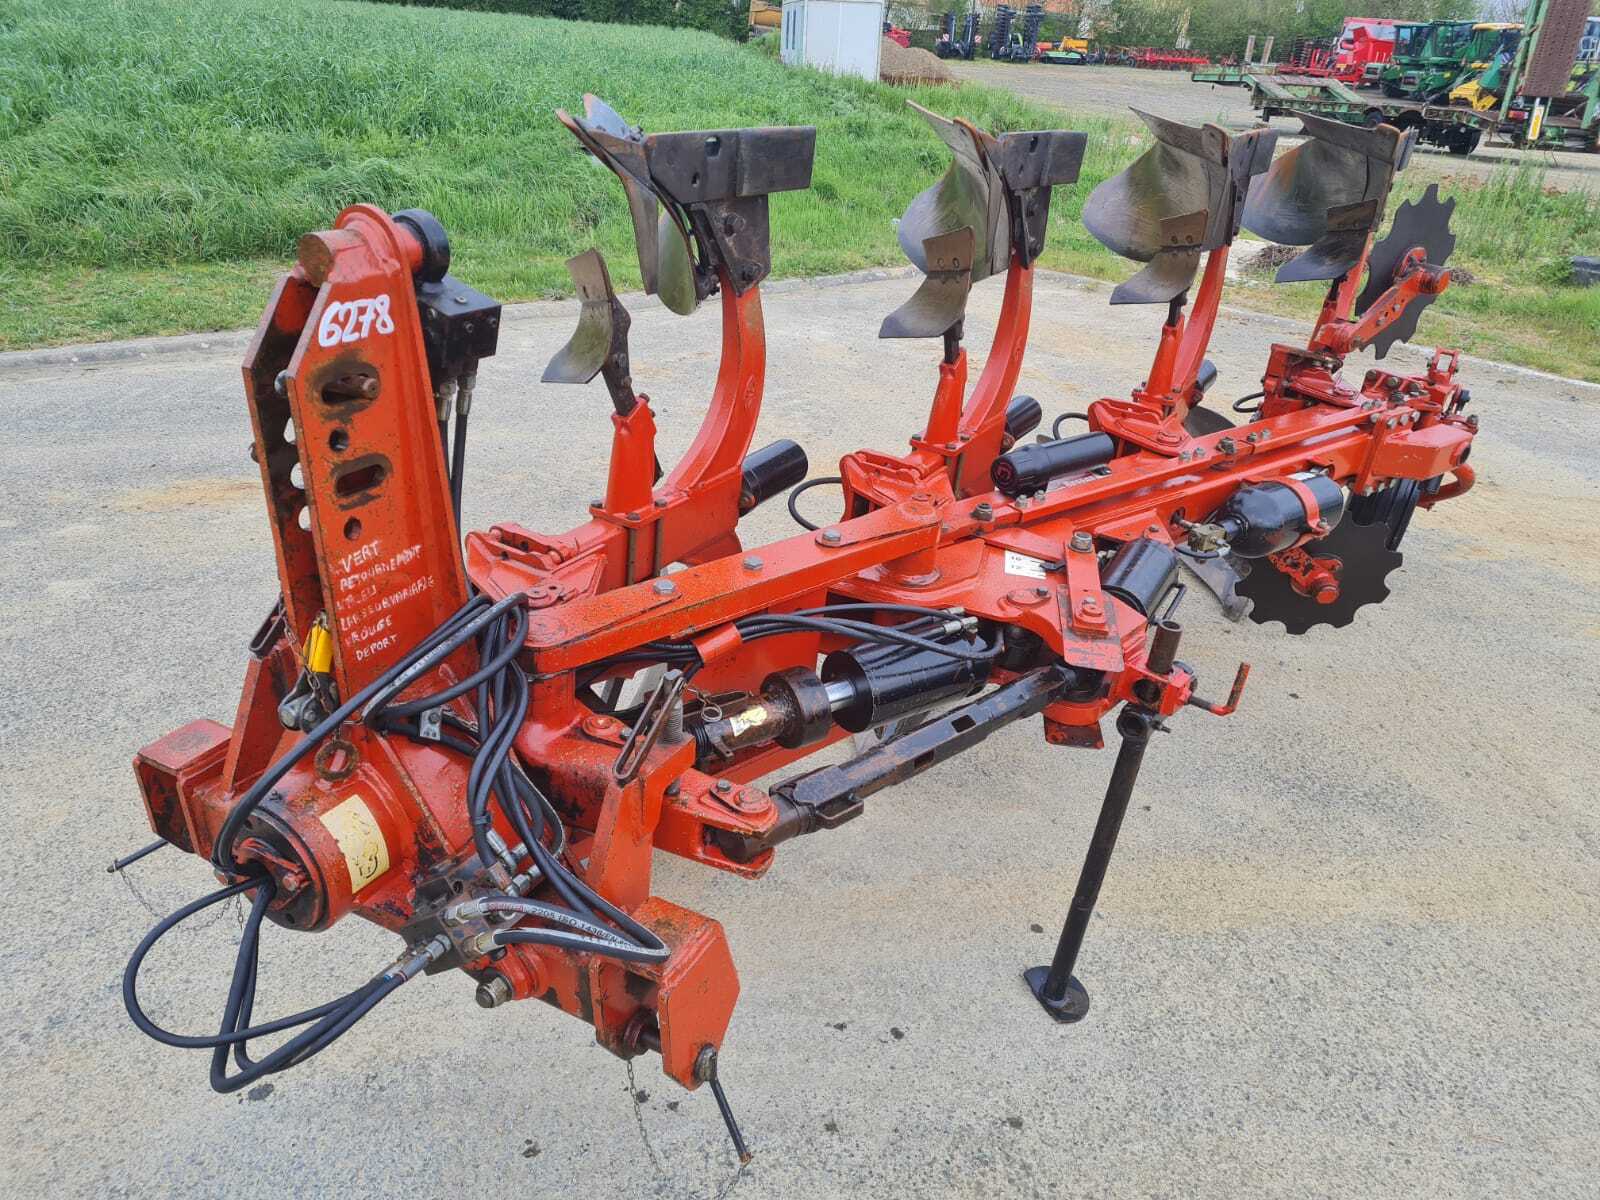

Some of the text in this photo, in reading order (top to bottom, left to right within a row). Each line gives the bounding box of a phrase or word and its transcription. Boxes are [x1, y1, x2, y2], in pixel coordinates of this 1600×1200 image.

[318, 293, 395, 348] 6278
[341, 540, 381, 573] VERT
[355, 633, 398, 661] DEPORT
